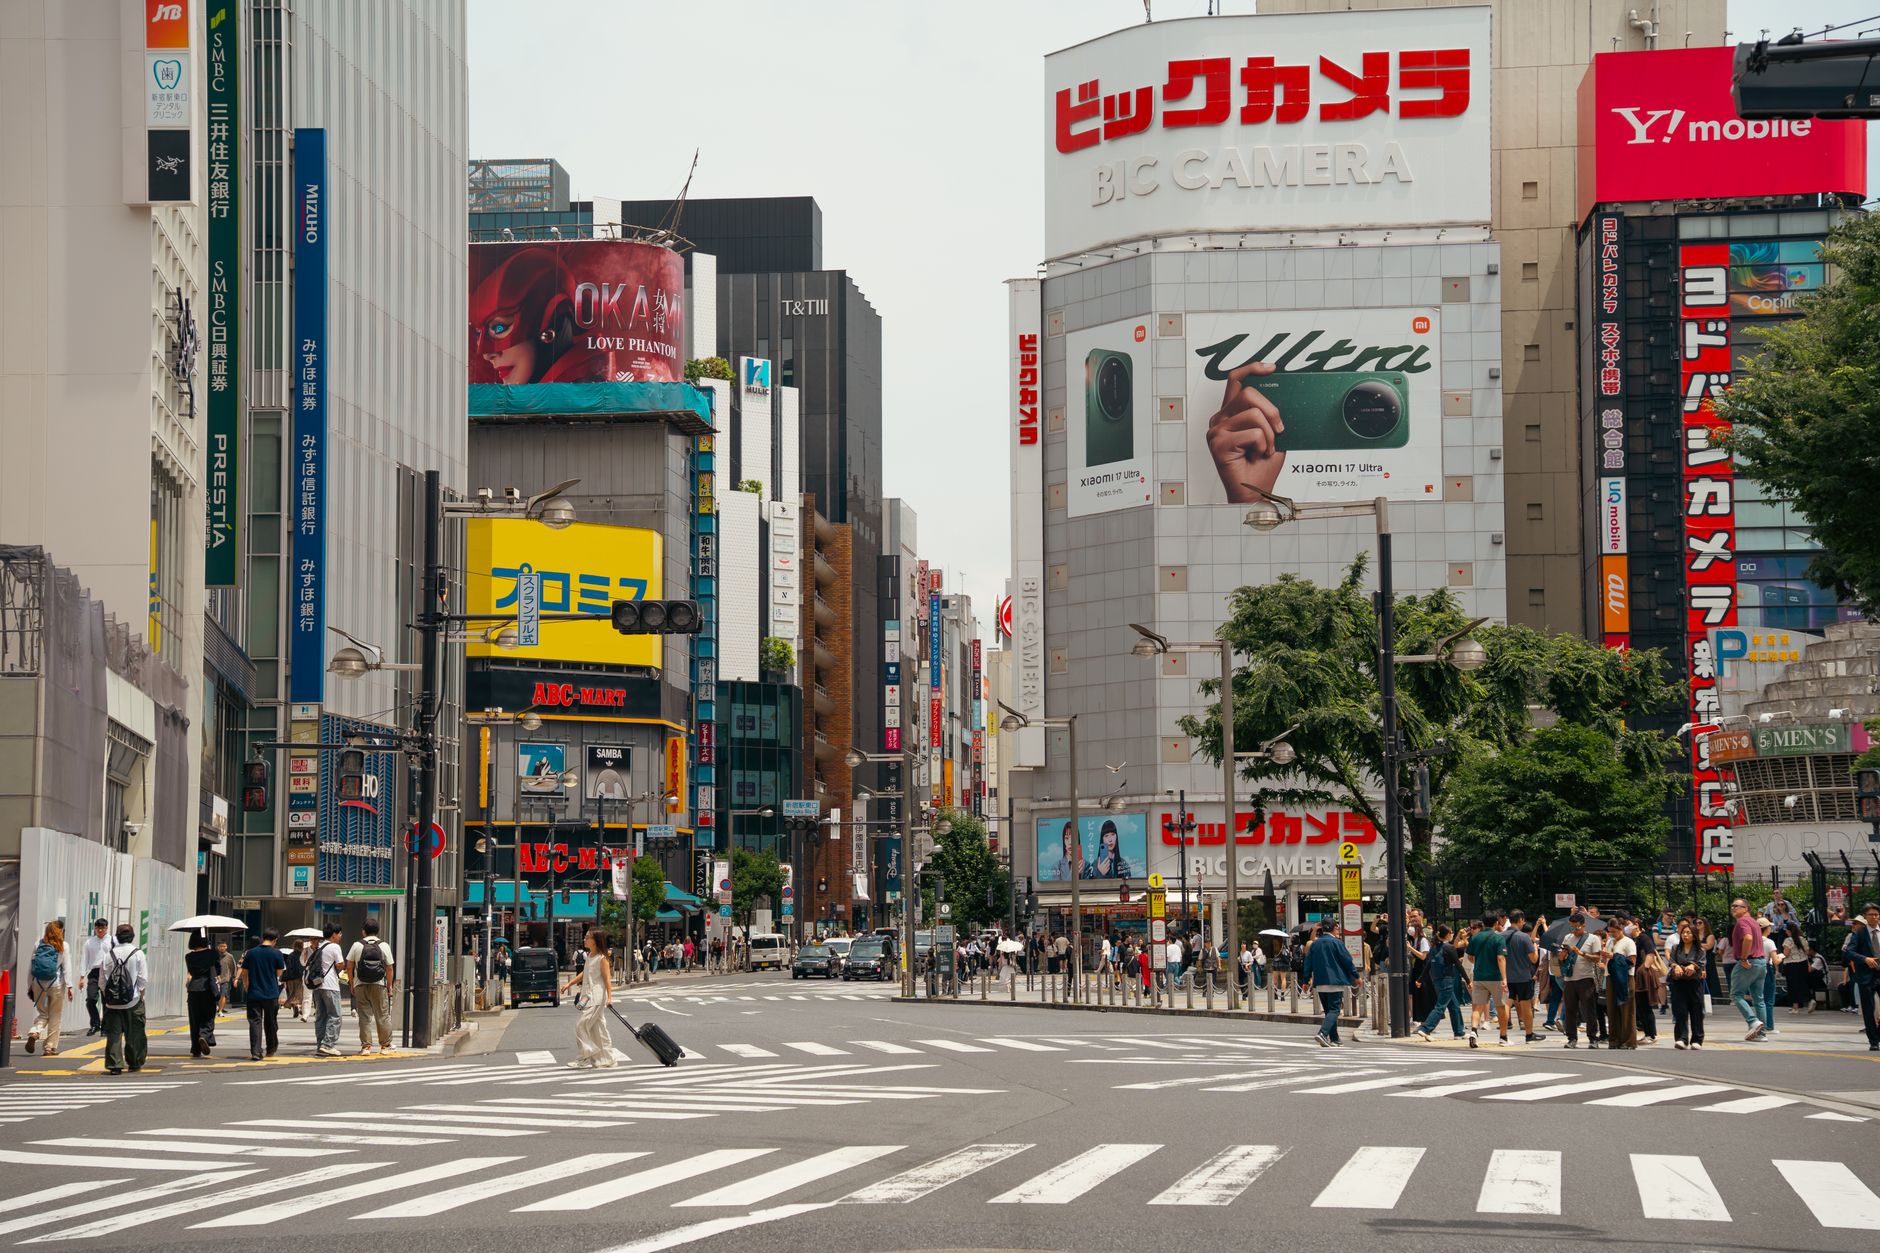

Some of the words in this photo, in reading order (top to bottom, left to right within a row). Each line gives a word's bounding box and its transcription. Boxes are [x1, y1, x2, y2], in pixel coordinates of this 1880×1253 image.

[152, 4, 182, 22] JTB
[211, 33, 226, 92] SMBC
[152, 93, 187, 101] 新宿駅東口
[152, 111, 183, 119] クリニック
[1056, 48, 1470, 153] ビックカメラ
[1611, 107, 1686, 145] Y!
[210, 103, 230, 219] 三井住友銀行
[1091, 155, 1159, 208] BIC
[1172, 142, 1413, 190] CAMERA
[305, 183, 319, 244] MIZUHO
[1602, 218, 1618, 314] ヨドバシカメラ
[211, 261, 228, 392] SMBC日興証券
[587, 337, 624, 350] LOVE
[629, 338, 677, 360] PHANTOM
[1195, 330, 1432, 381] Ultra
[1602, 323, 1620, 395] スマホ・携帯
[302, 339, 318, 411] みずほ証券
[745, 387, 770, 396] HULIC
[1019, 334, 1037, 445] ビックカメラ
[301, 434, 317, 535] みずほ信託銀行
[1080, 473, 1114, 487] xiaomi
[1115, 472, 1122, 481] 17
[1123, 469, 1141, 480] Ultra
[1292, 464, 1342, 473] xiaomi
[1345, 464, 1356, 473] 17
[1359, 463, 1383, 473] Ultra
[1610, 506, 1621, 550] mobile
[300, 559, 316, 632] みずほ銀行
[522, 577, 535, 643] スクランブル式
[1022, 577, 1039, 614] BIC
[1607, 573, 1625, 615] au
[1716, 631, 1747, 676] P
[532, 683, 627, 707] ABC-MART
[596, 748, 622, 759] SAMBA
[1774, 728, 1837, 747] MEN'S
[293, 778, 310, 786] 眼科
[1161, 812, 1377, 845] ビックカメラ
[887, 848, 900, 880] Disney
[1344, 845, 1354, 858] 2
